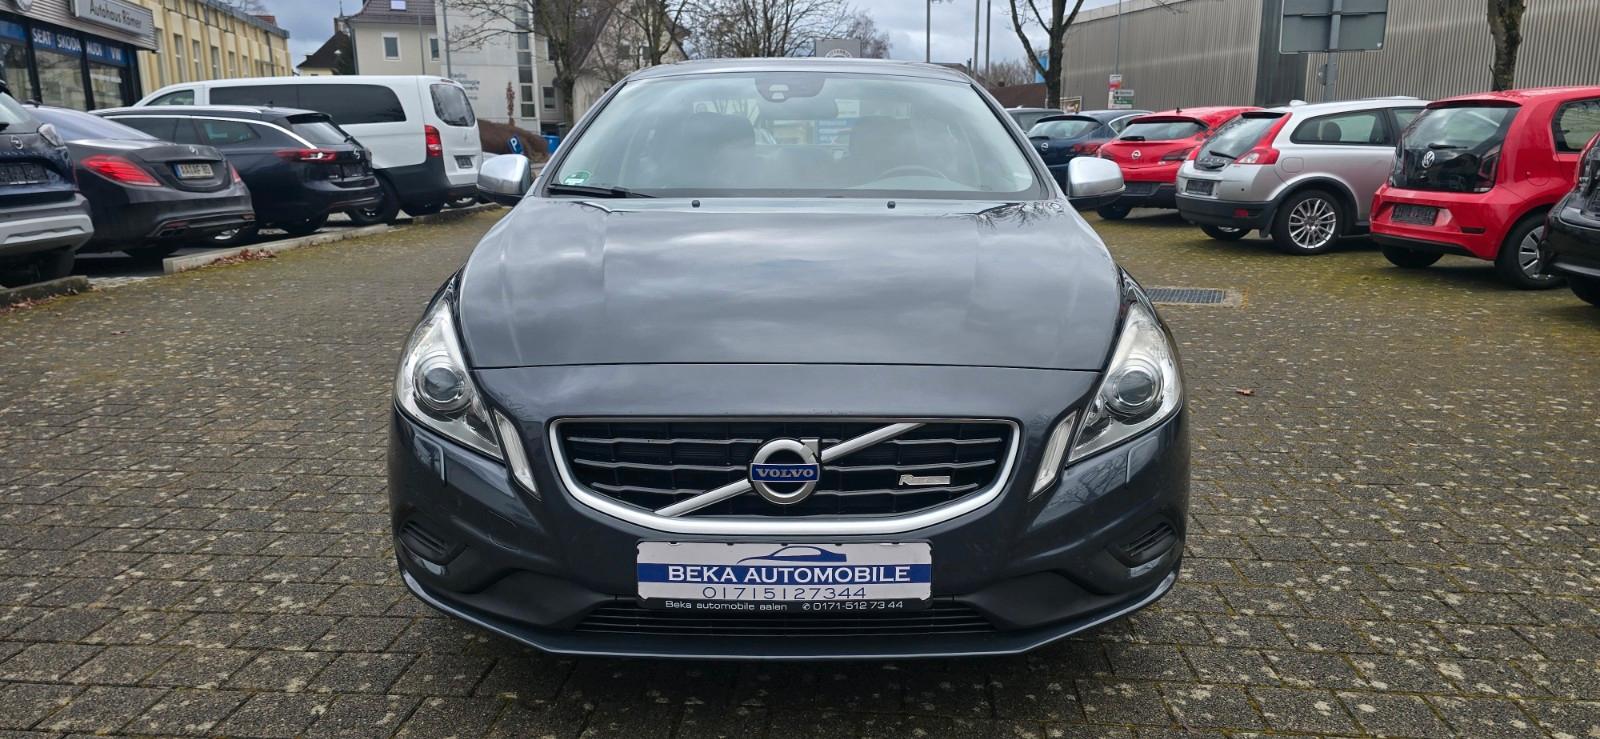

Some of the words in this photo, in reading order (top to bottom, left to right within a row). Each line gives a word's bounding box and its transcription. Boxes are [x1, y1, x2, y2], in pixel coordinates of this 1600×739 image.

[89, 0, 121, 24] Autohaus
[32, 27, 51, 45] SEAT
[57, 34, 82, 52] SKODA
[510, 137, 518, 152] P
[755, 468, 814, 478] VOLVO
[668, 565, 738, 583] BEKA
[743, 566, 911, 583] AUTOMOBILE
[702, 586, 867, 600] 01715127344
[665, 600, 692, 609] Beka
[696, 602, 755, 611] automobile
[869, 601, 885, 609] 73
[887, 601, 903, 609] 44
